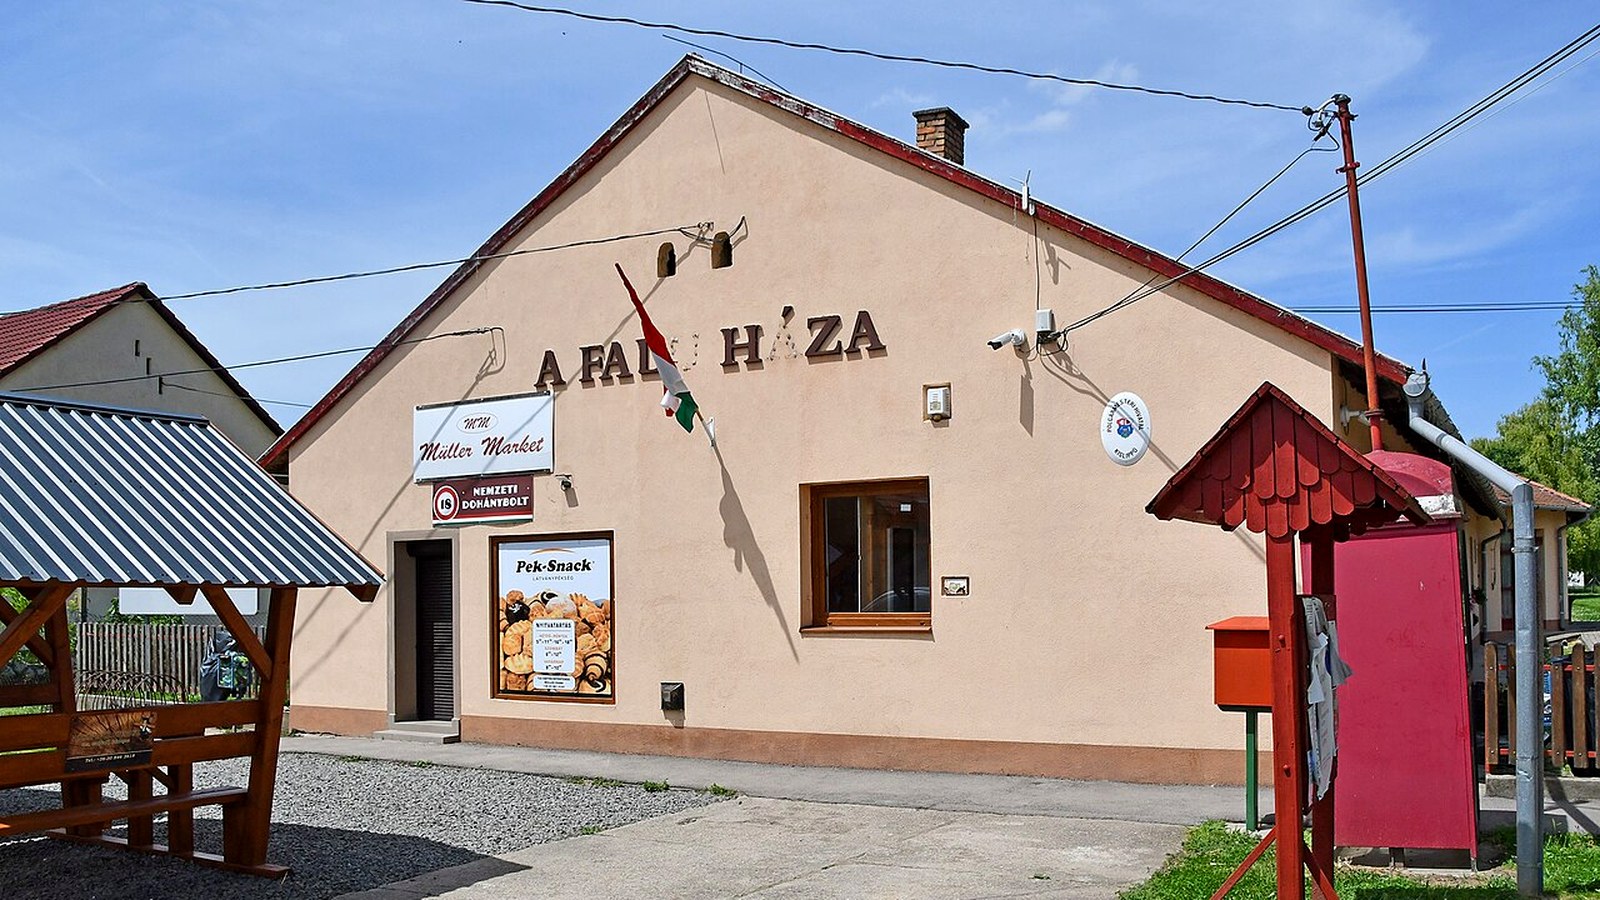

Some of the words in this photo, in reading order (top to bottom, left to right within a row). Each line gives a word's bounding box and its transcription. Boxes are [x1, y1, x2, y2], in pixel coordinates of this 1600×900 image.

[534, 349, 567, 388] A
[464, 415, 491, 430] MM
[419, 441, 474, 461] Müller
[481, 434, 545, 456] Market
[473, 484, 519, 496] NEMZETI
[440, 498, 453, 511] 18
[462, 497, 529, 509] DOHÁNYBOLT
[516, 559, 591, 573] Pek-Snack
